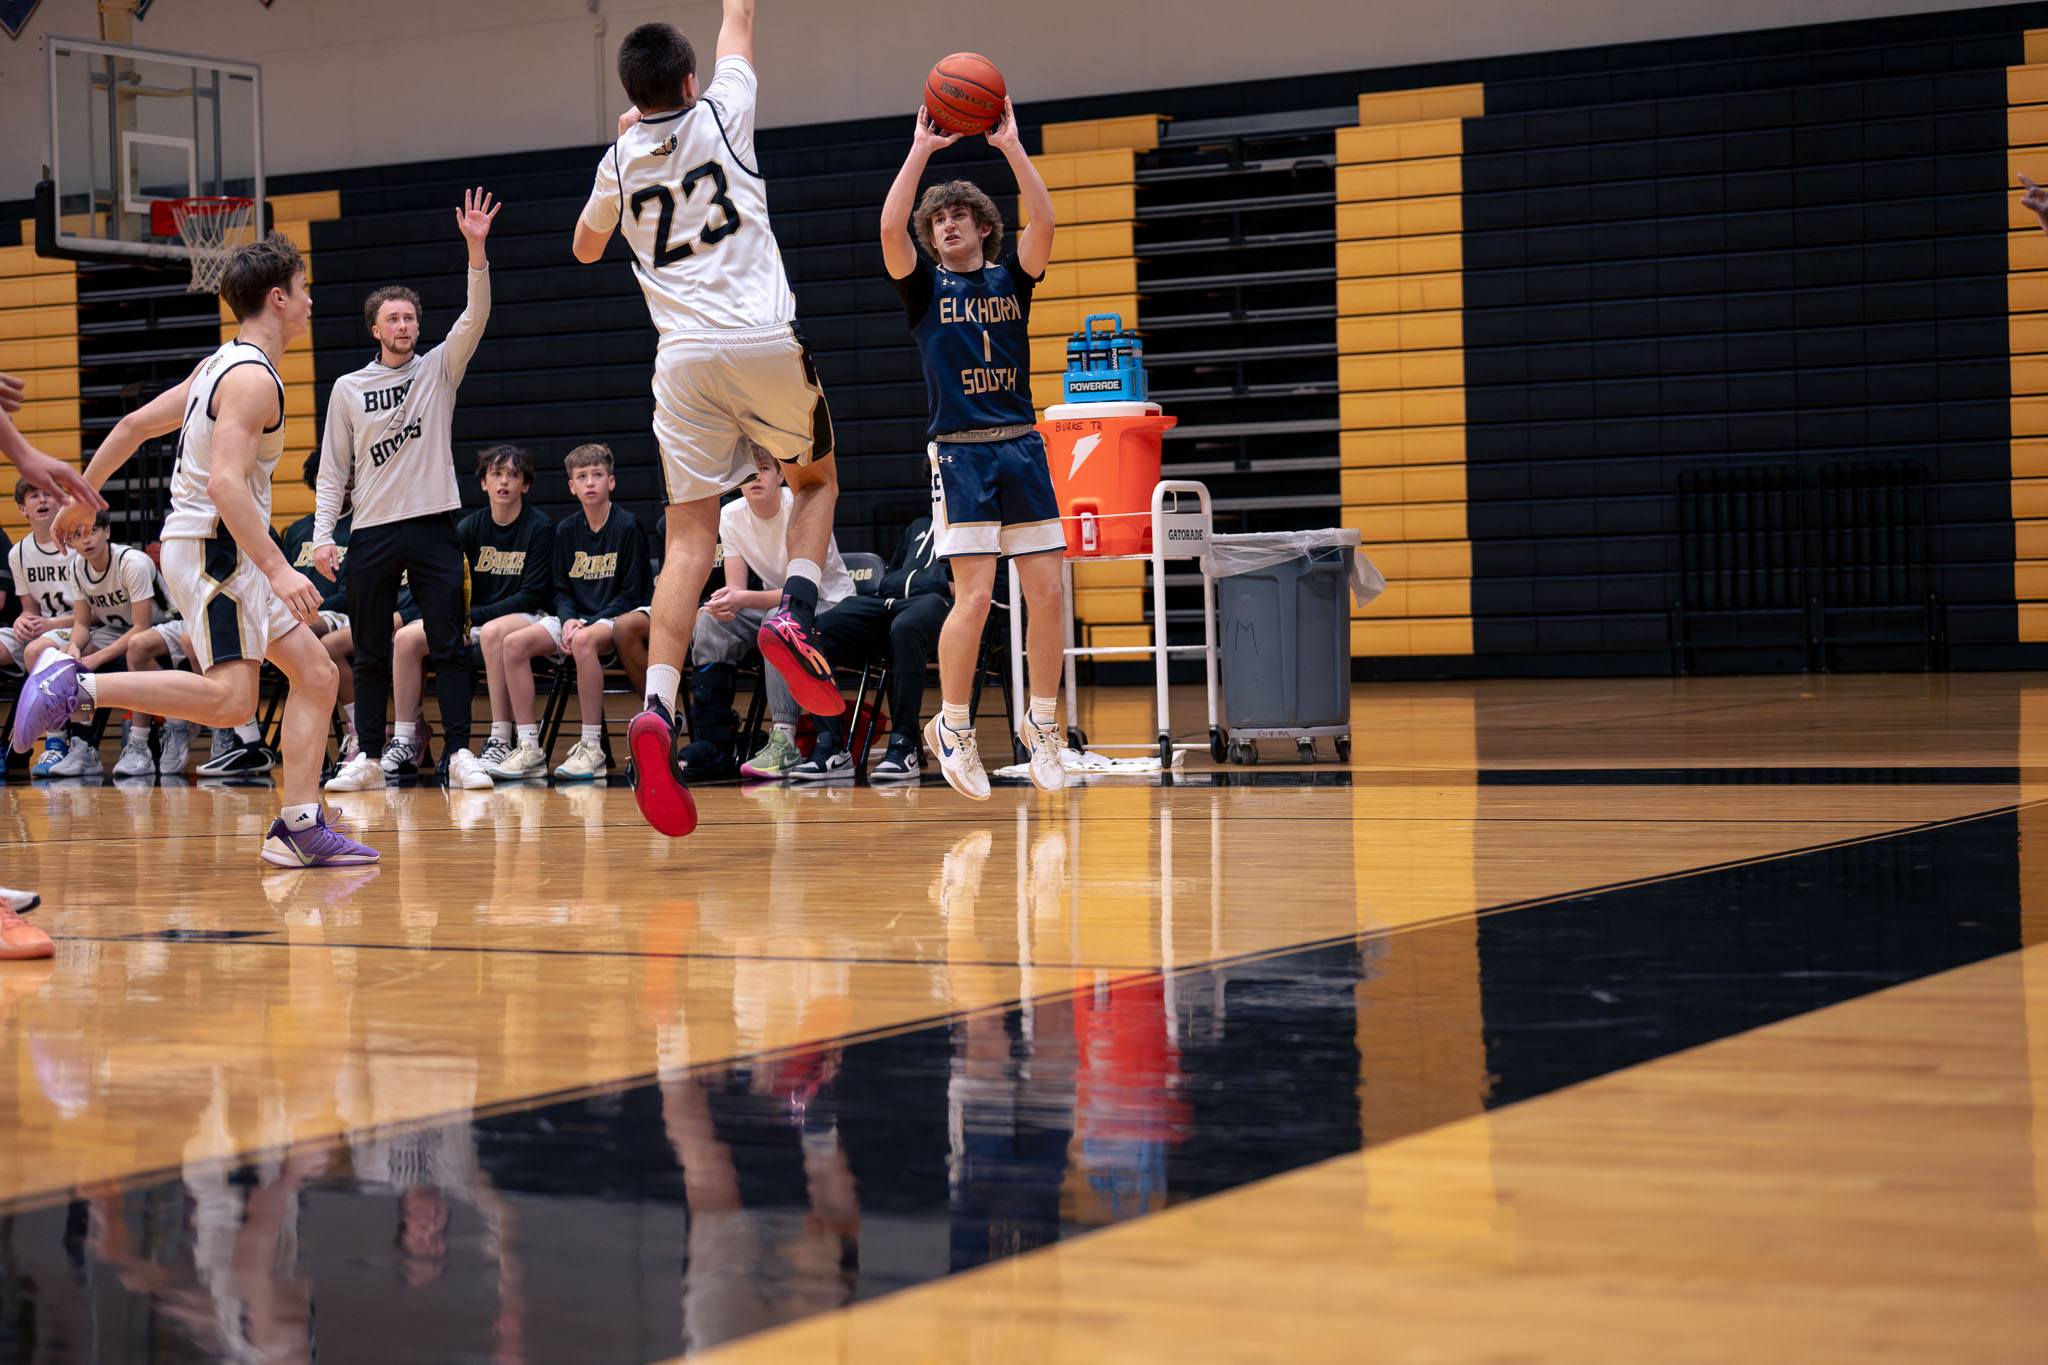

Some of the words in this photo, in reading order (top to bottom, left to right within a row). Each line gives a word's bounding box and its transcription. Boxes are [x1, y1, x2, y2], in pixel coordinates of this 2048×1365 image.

[629, 158, 743, 270] 23
[940, 295, 1022, 324] ELKHORN
[983, 330, 992, 362] 1
[961, 367, 1018, 395] SOUTH
[1069, 381, 1121, 392] POWERADE
[1055, 421, 1084, 432] BURKE
[1168, 529, 1204, 541] GATORADE
[26, 566, 72, 583] BURK
[41, 592, 74, 618] 11
